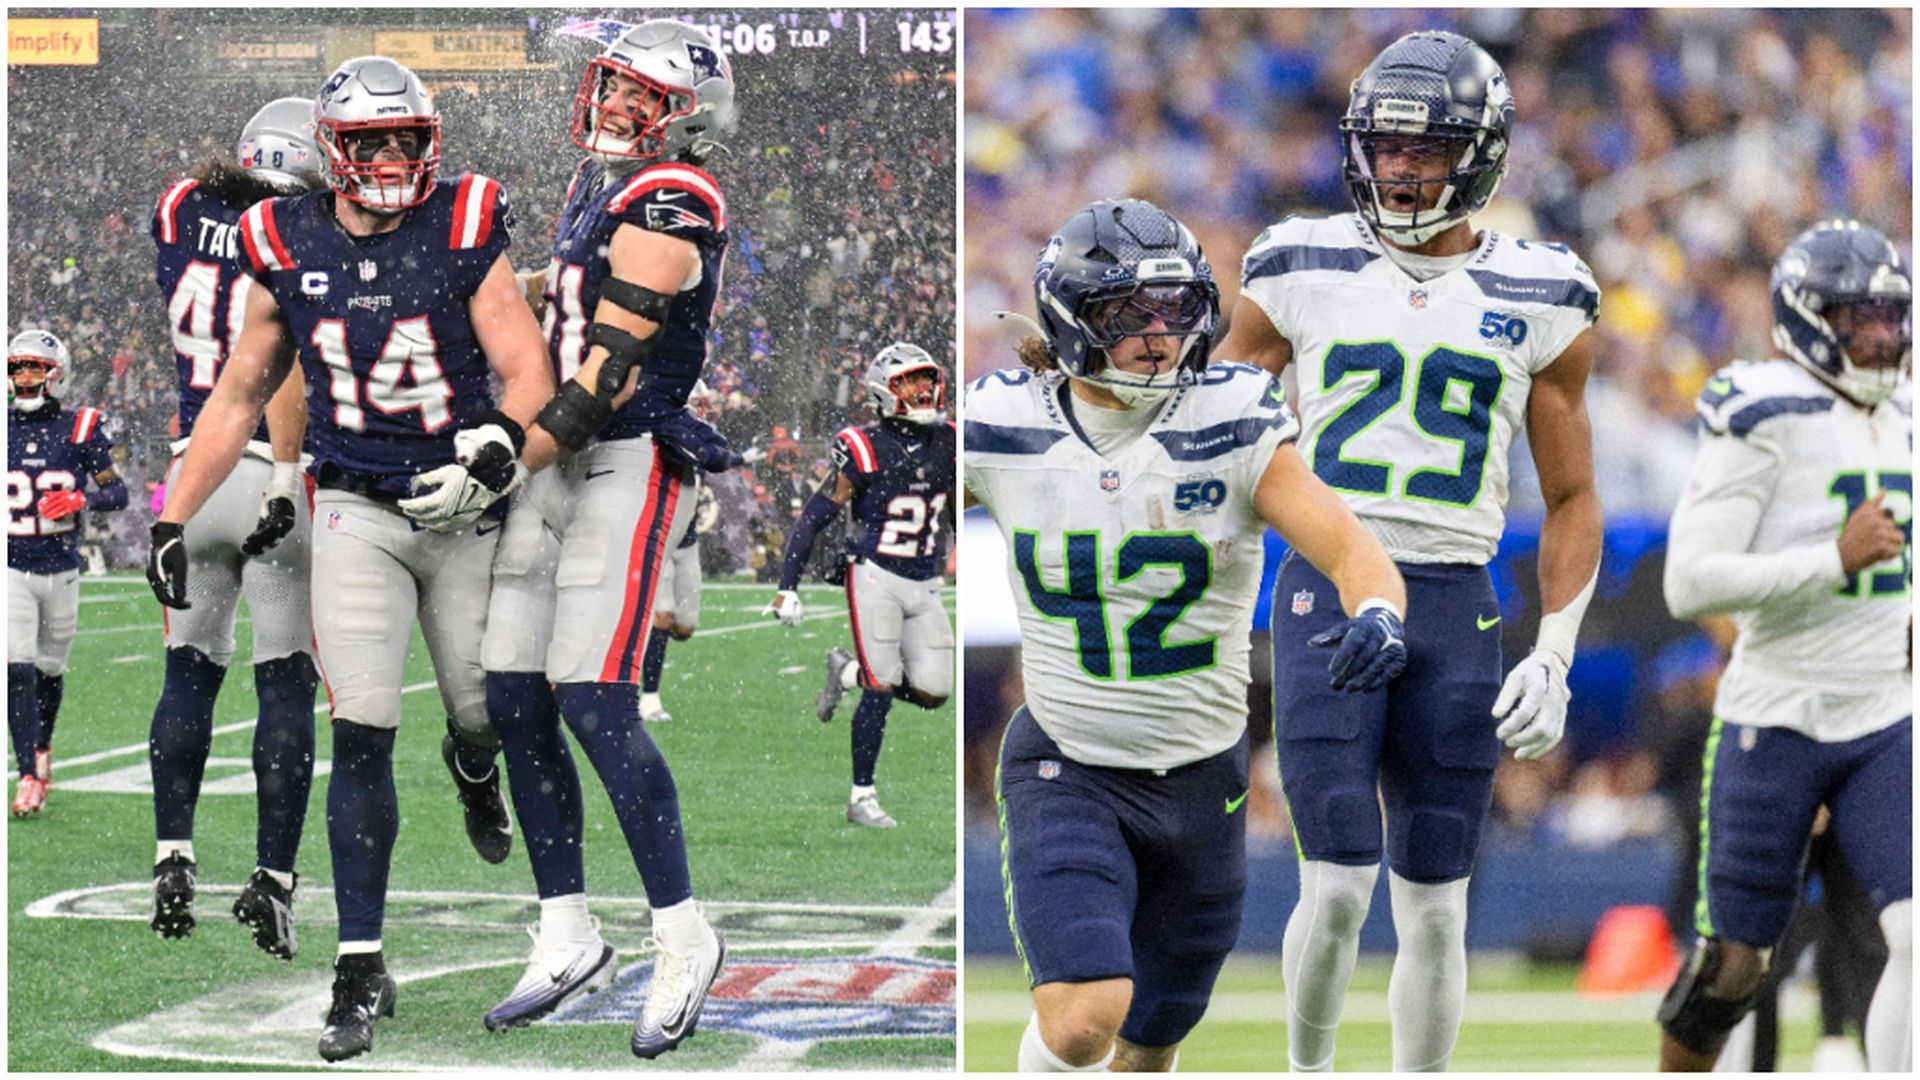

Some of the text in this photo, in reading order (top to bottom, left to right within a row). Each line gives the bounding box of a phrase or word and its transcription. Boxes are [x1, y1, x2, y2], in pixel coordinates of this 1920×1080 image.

[692, 23, 830, 54] 1:06 T.O.P
[898, 22, 952, 52] 143
[301, 271, 329, 295] C
[1479, 311, 1528, 346] 50
[311, 314, 452, 433] 14
[1311, 339, 1506, 509] 29
[1174, 479, 1227, 511] 50
[877, 492, 947, 559] 21
[1013, 529, 1217, 682] 42
